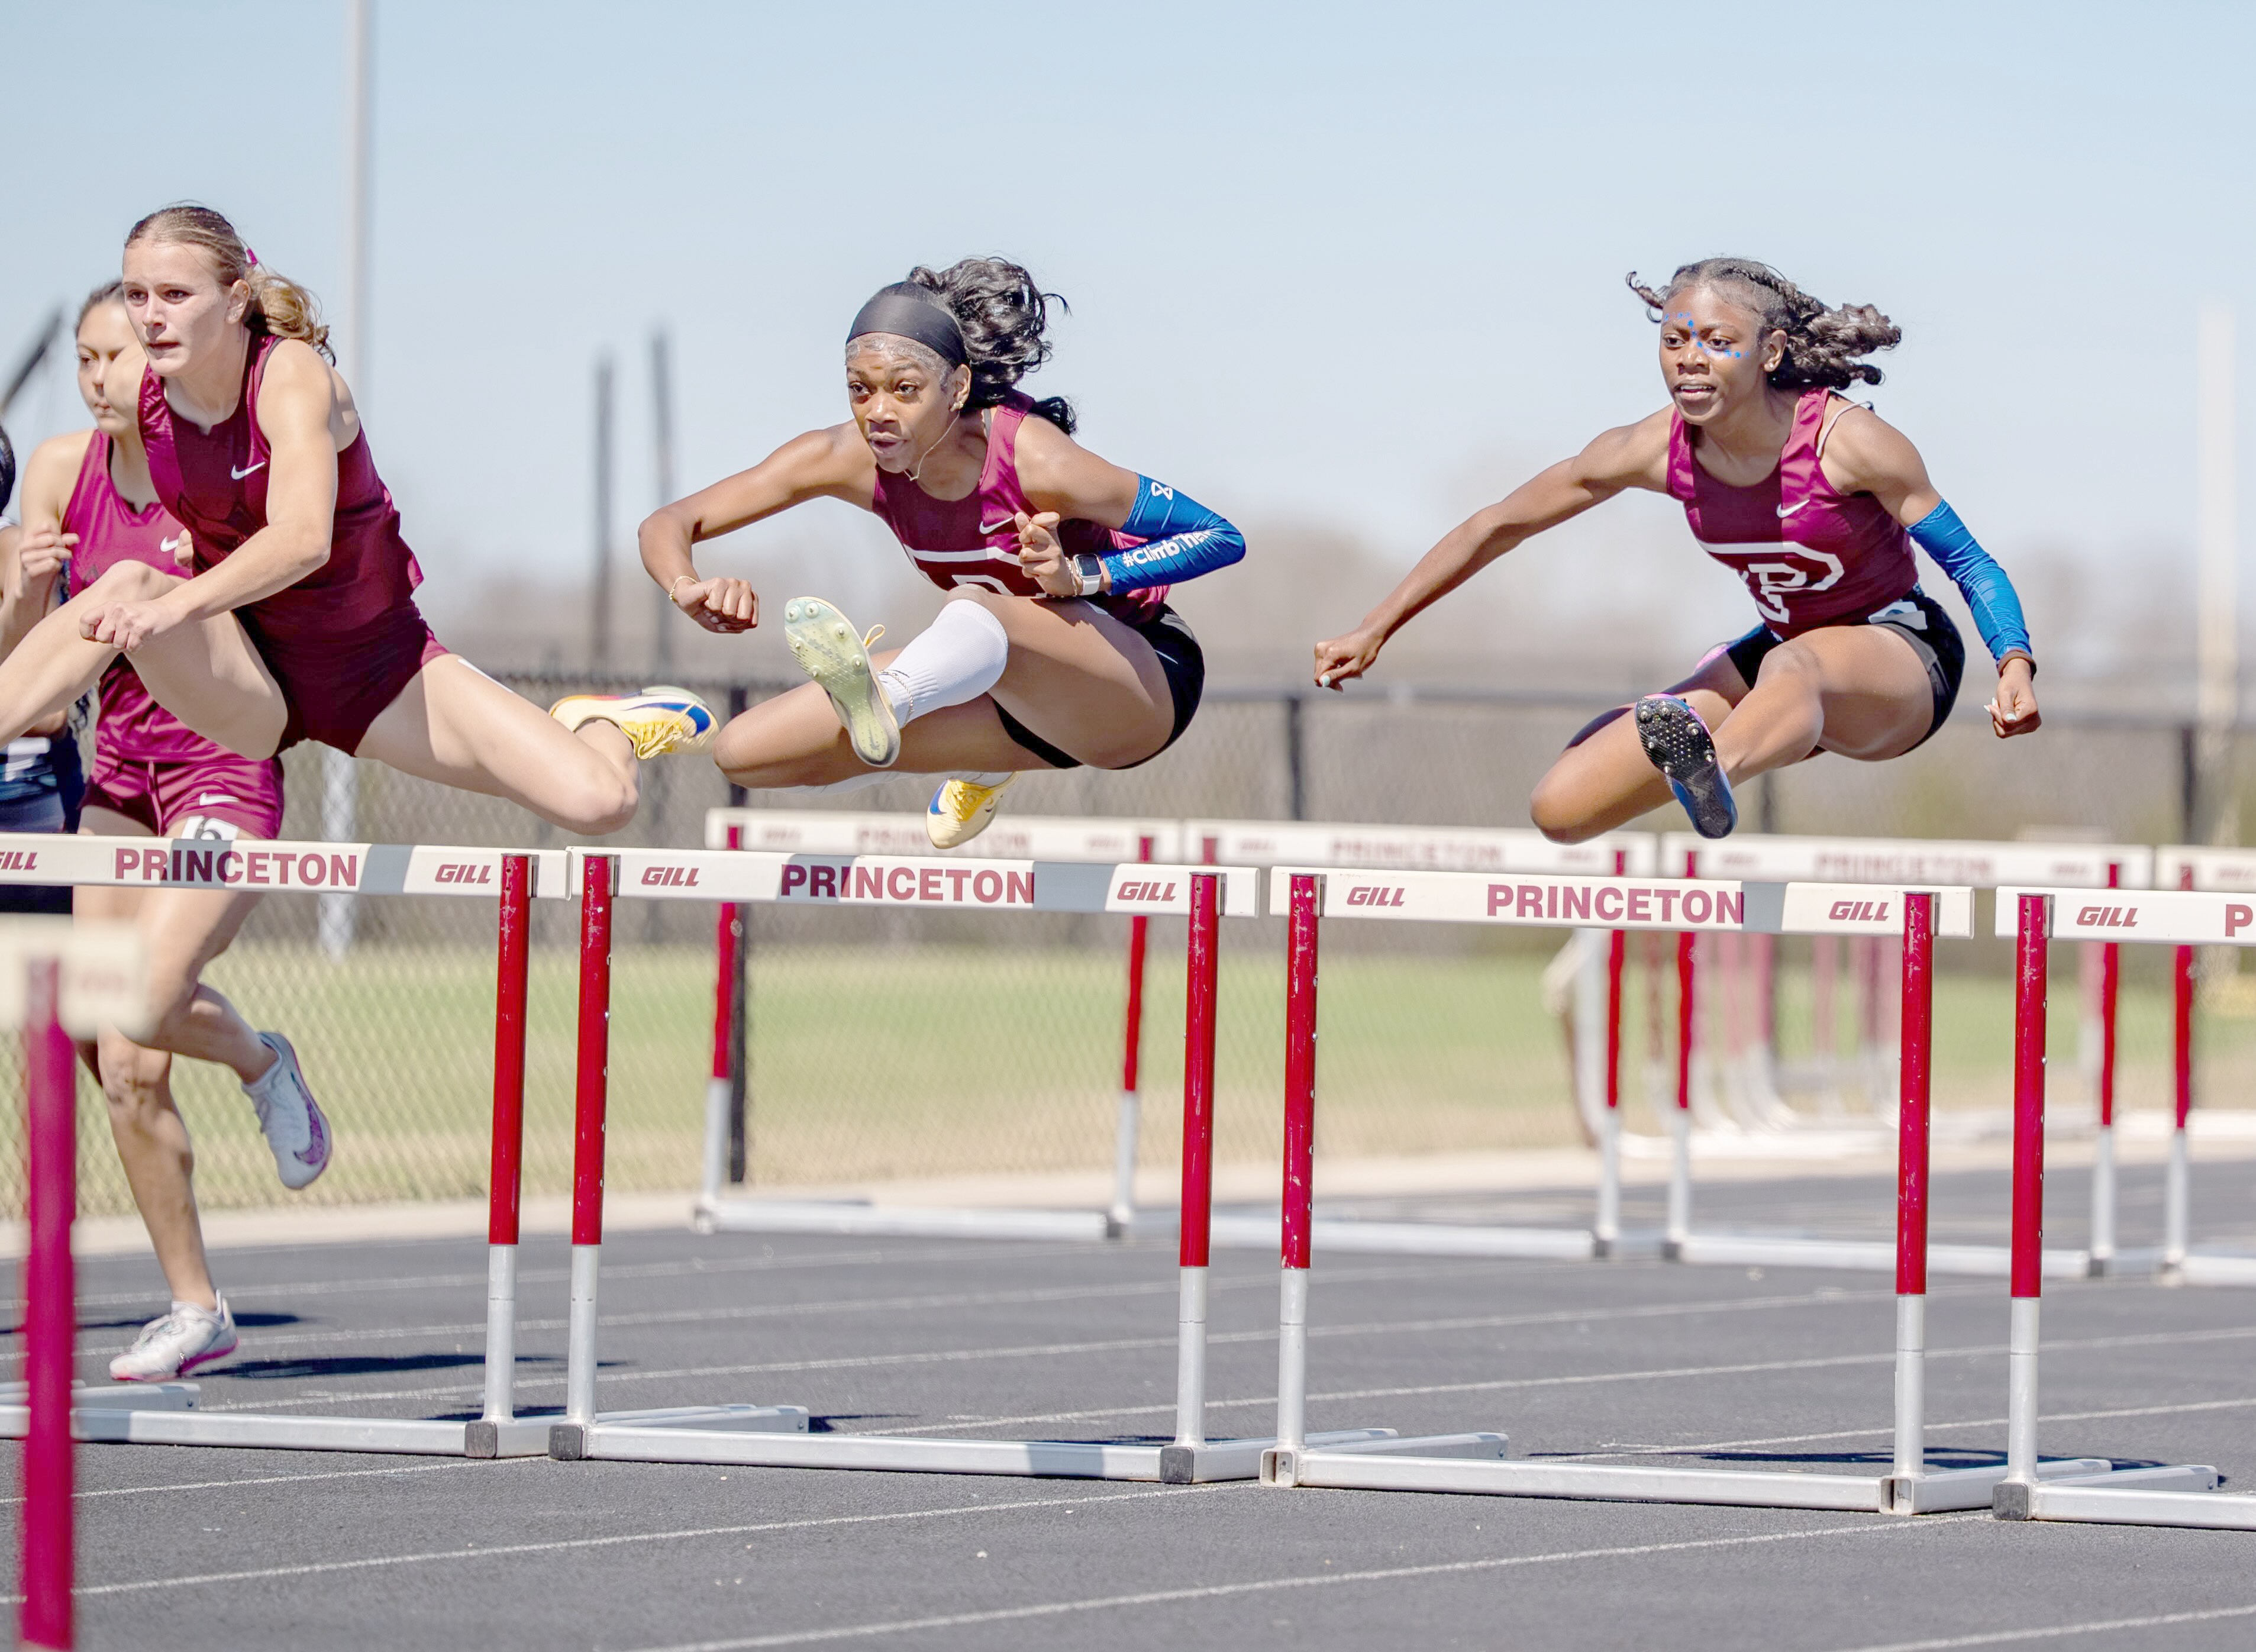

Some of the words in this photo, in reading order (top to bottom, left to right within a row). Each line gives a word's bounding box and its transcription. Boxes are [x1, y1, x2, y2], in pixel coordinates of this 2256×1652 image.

[115, 847, 356, 886] PRINCETON
[435, 864, 490, 884] GILL
[641, 867, 699, 887] GILL
[780, 863, 1035, 904] PRINCETON
[1117, 880, 1176, 902] GILL
[1346, 886, 1405, 906] GILL
[1487, 883, 1744, 924] PRINCETON
[1828, 901, 1889, 922] GILL
[2076, 906, 2138, 928] GILL
